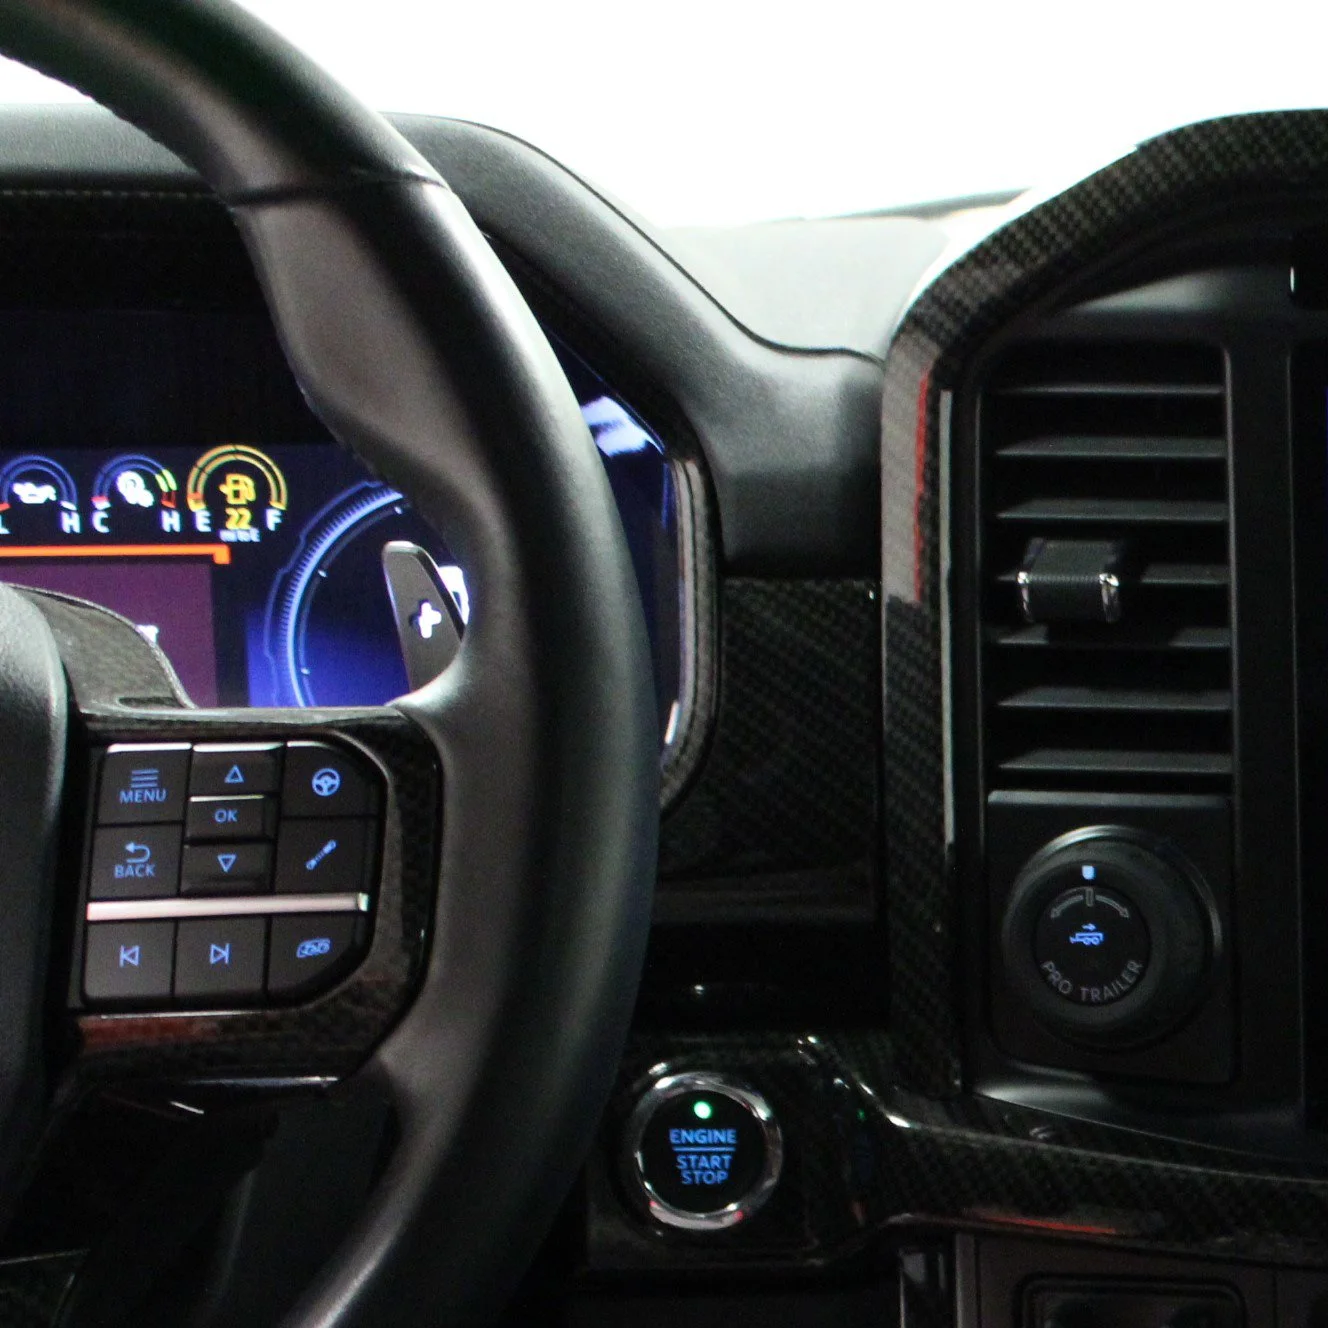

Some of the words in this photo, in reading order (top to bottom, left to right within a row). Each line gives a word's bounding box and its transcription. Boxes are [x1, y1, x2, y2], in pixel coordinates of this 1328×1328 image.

[61, 511, 80, 533] H
[92, 511, 110, 533] C
[162, 510, 180, 532] H
[195, 509, 211, 532] E
[225, 508, 251, 530] 22
[266, 508, 282, 531] F
[119, 788, 166, 803] MENU
[215, 810, 237, 823] OK
[114, 864, 155, 878] BACK
[1041, 961, 1073, 994] PRO
[1080, 960, 1143, 1001] TRAILER
[669, 1129, 737, 1144] ENGINE
[676, 1155, 732, 1170] START
[681, 1171, 728, 1185] STOP
